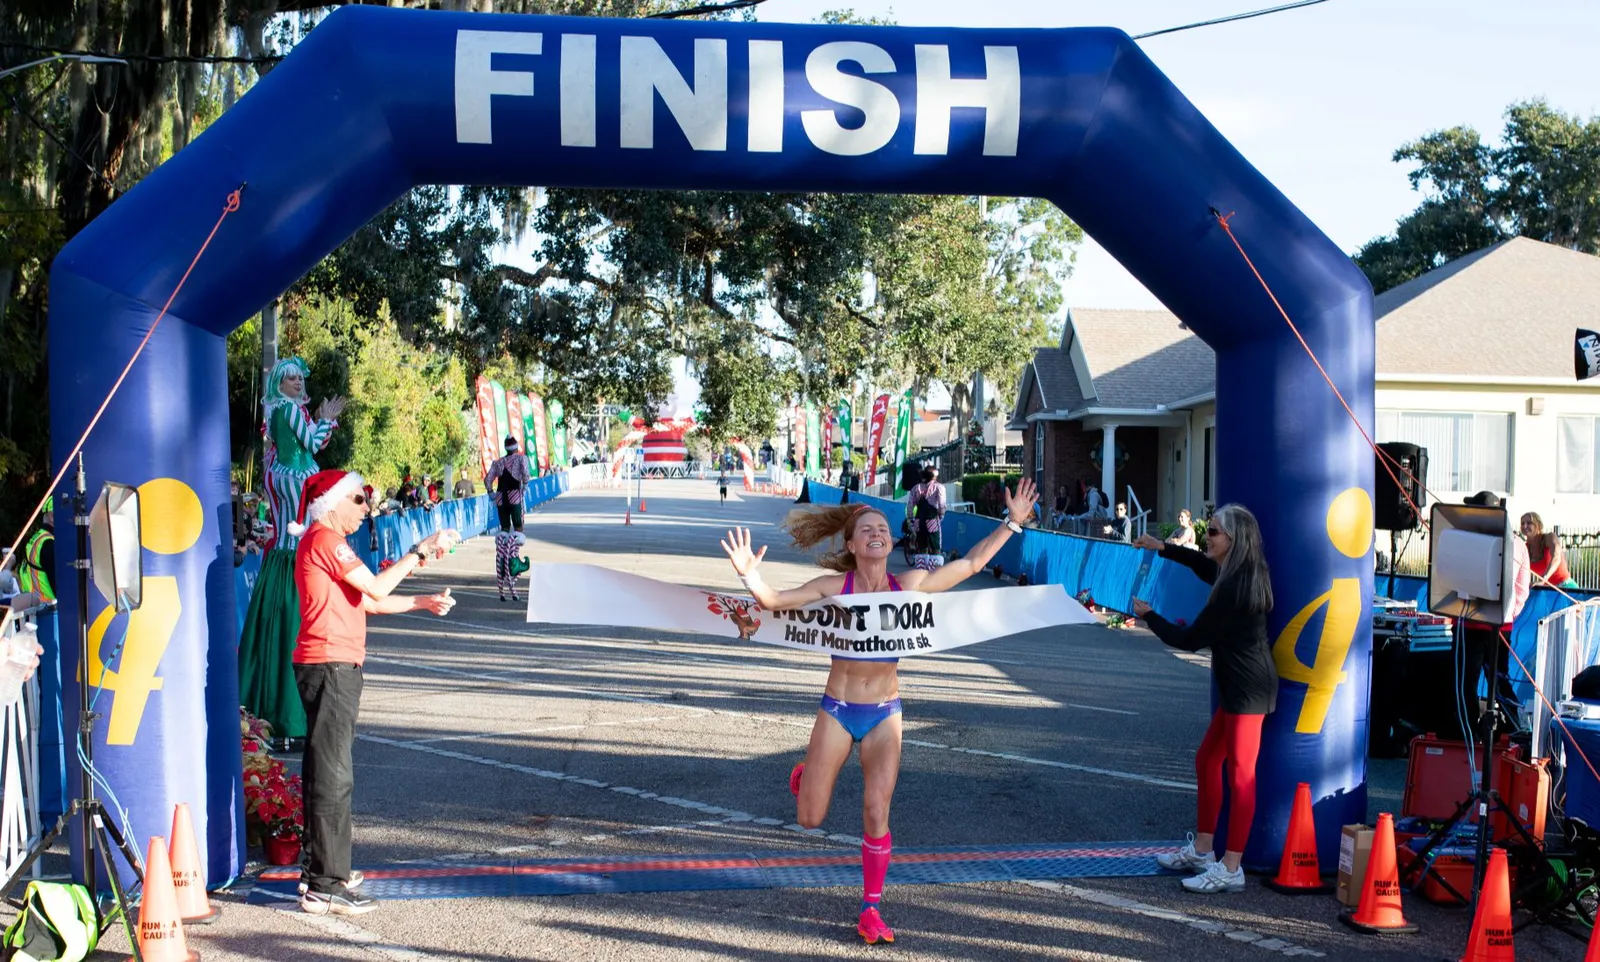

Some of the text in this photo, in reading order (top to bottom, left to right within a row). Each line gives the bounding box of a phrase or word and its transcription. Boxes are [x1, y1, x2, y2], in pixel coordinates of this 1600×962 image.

[455, 29, 1021, 156] FINISH
[879, 602, 935, 631] DORA
[785, 624, 819, 645] Half
[821, 630, 906, 652] Marathon
[907, 638, 916, 650] &
[172, 870, 182, 878] UN
[1374, 880, 1392, 888] RUN
[141, 921, 161, 930] RUN
[1485, 928, 1505, 937] RUN
